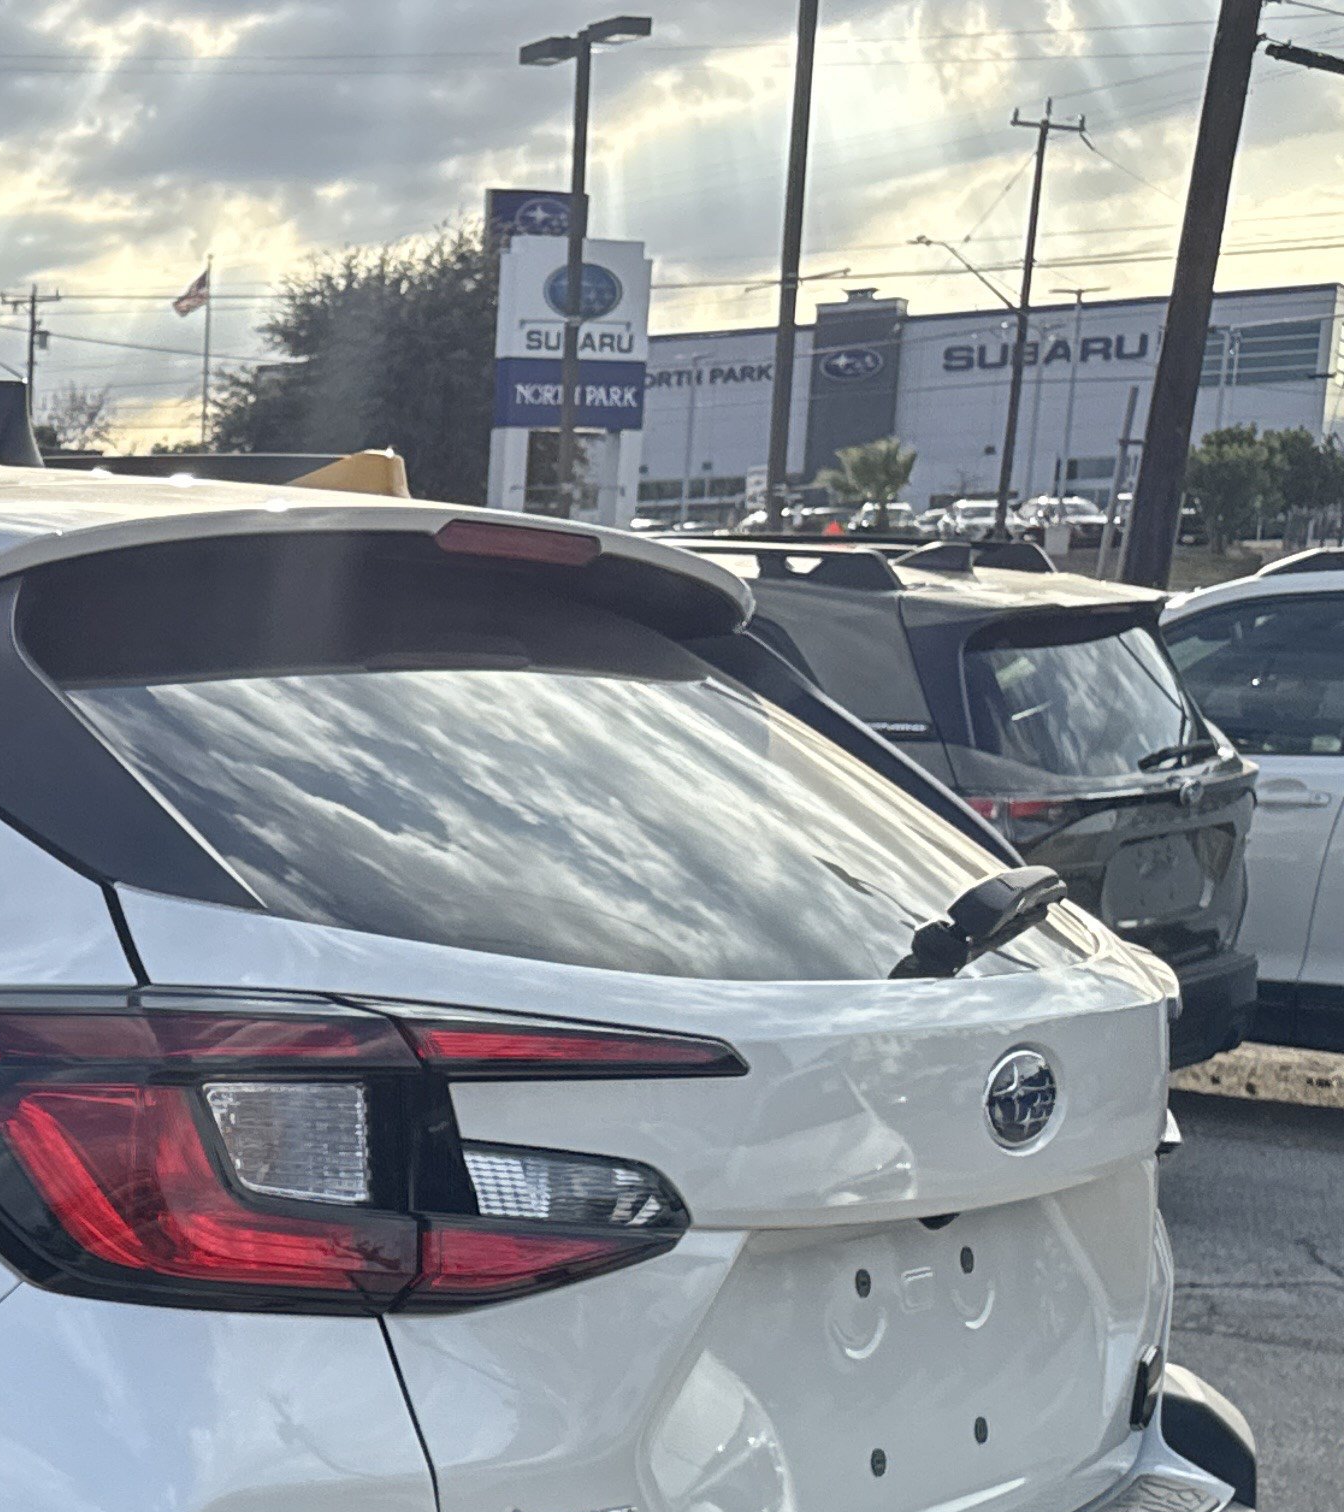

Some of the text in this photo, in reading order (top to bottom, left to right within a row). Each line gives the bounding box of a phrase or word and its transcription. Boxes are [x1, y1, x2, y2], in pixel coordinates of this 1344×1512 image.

[525, 329, 634, 354] SUARU
[709, 363, 773, 385] PARK
[584, 385, 638, 408] PARK
